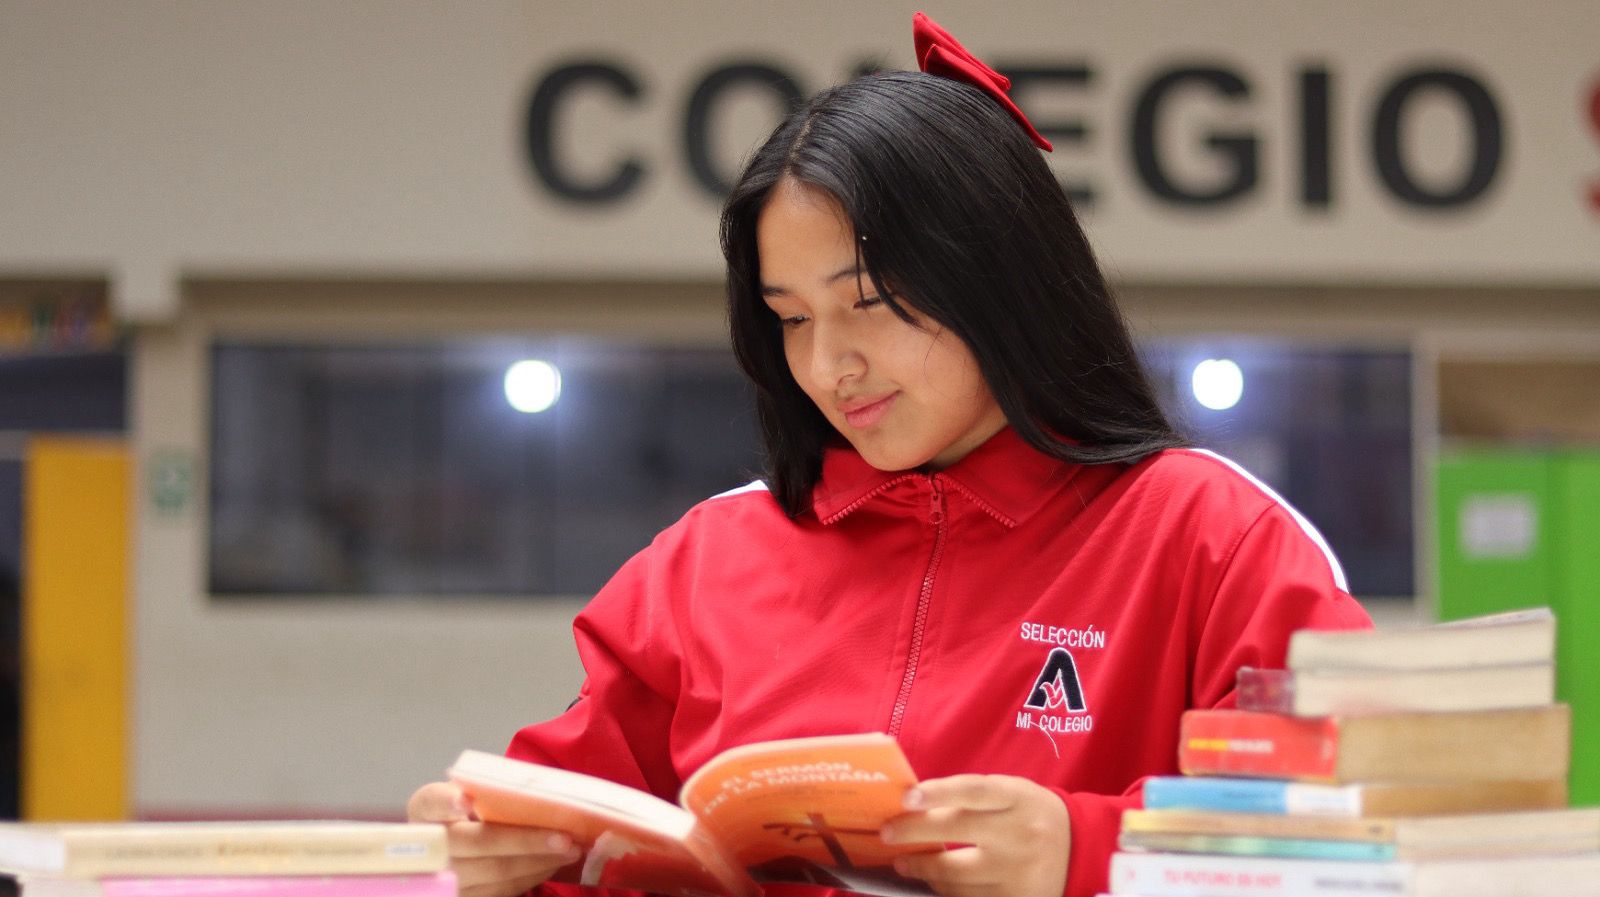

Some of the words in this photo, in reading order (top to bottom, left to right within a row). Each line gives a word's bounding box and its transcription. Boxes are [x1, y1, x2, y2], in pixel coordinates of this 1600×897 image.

[527, 60, 1505, 211] COEGIO
[1020, 622, 1105, 648] SELECCIÓN
[1016, 711, 1032, 729] MI
[1040, 714, 1093, 732] COLEGIO
[722, 776, 743, 790] EL
[751, 761, 851, 779] SERMÓN
[704, 794, 729, 815] DE
[733, 779, 763, 795] LA
[767, 769, 890, 786] MONTAÑA
